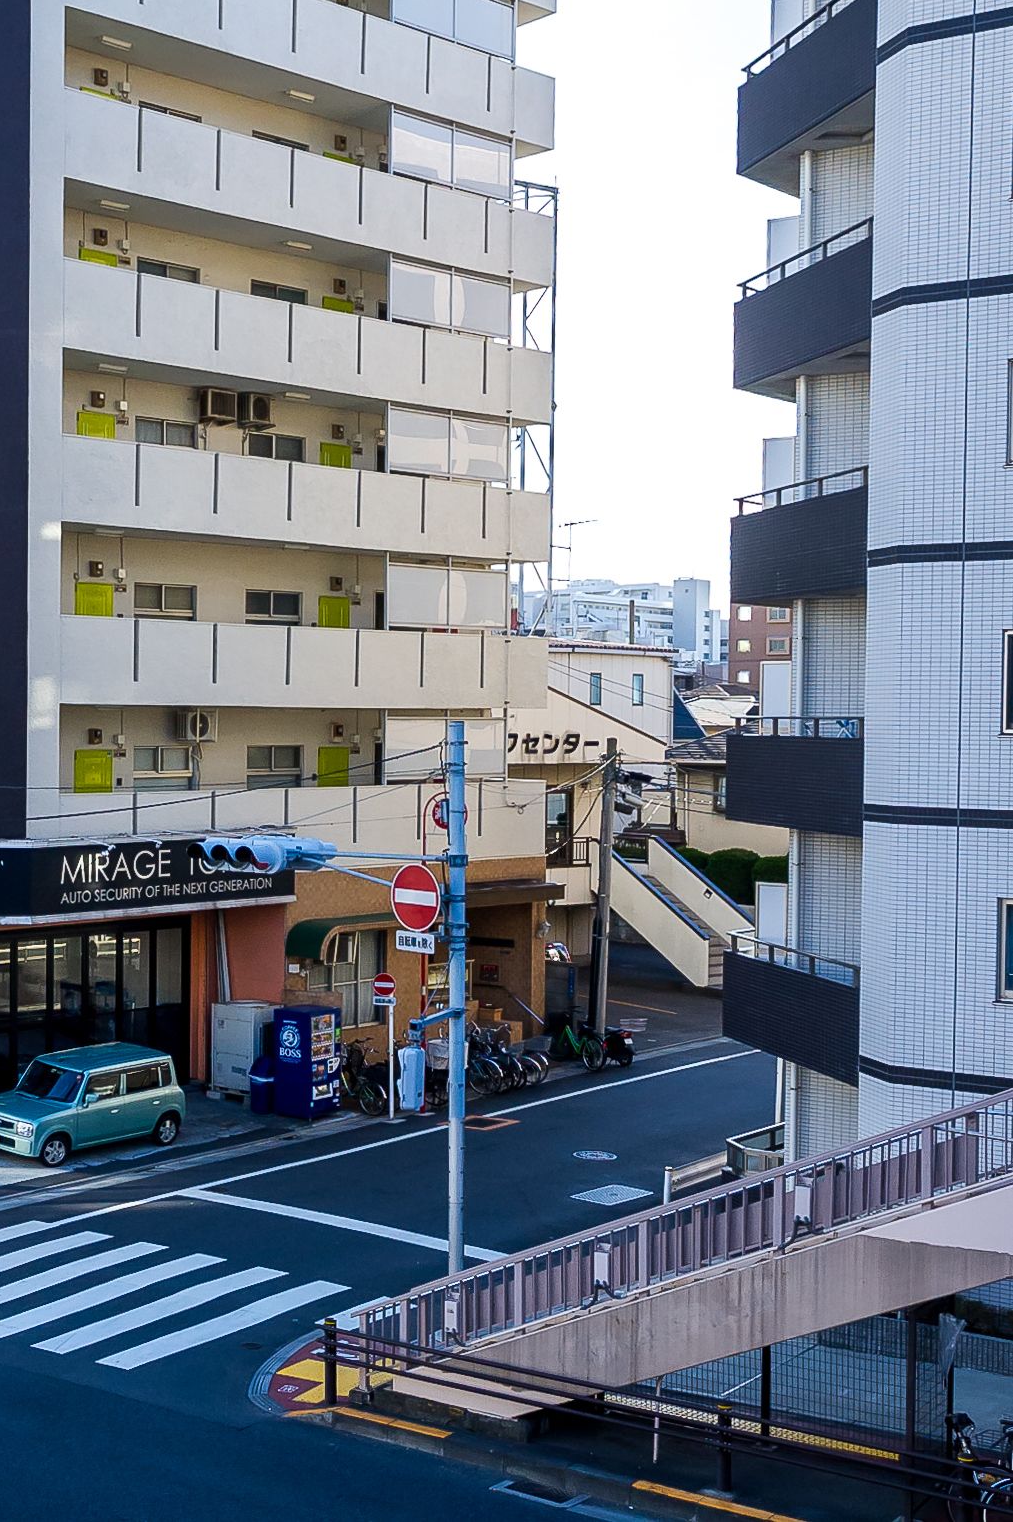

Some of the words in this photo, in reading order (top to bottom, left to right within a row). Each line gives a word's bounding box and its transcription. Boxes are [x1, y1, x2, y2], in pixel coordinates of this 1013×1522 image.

[60, 848, 172, 885] MIRAGE
[60, 889, 92, 905] AUTO
[94, 886, 143, 902] SECURITY
[145, 885, 160, 898] OF
[162, 883, 181, 896] THE
[182, 881, 207, 895] NEXT
[209, 877, 273, 893] GENERATION
[279, 1046, 302, 1059] BOSS
